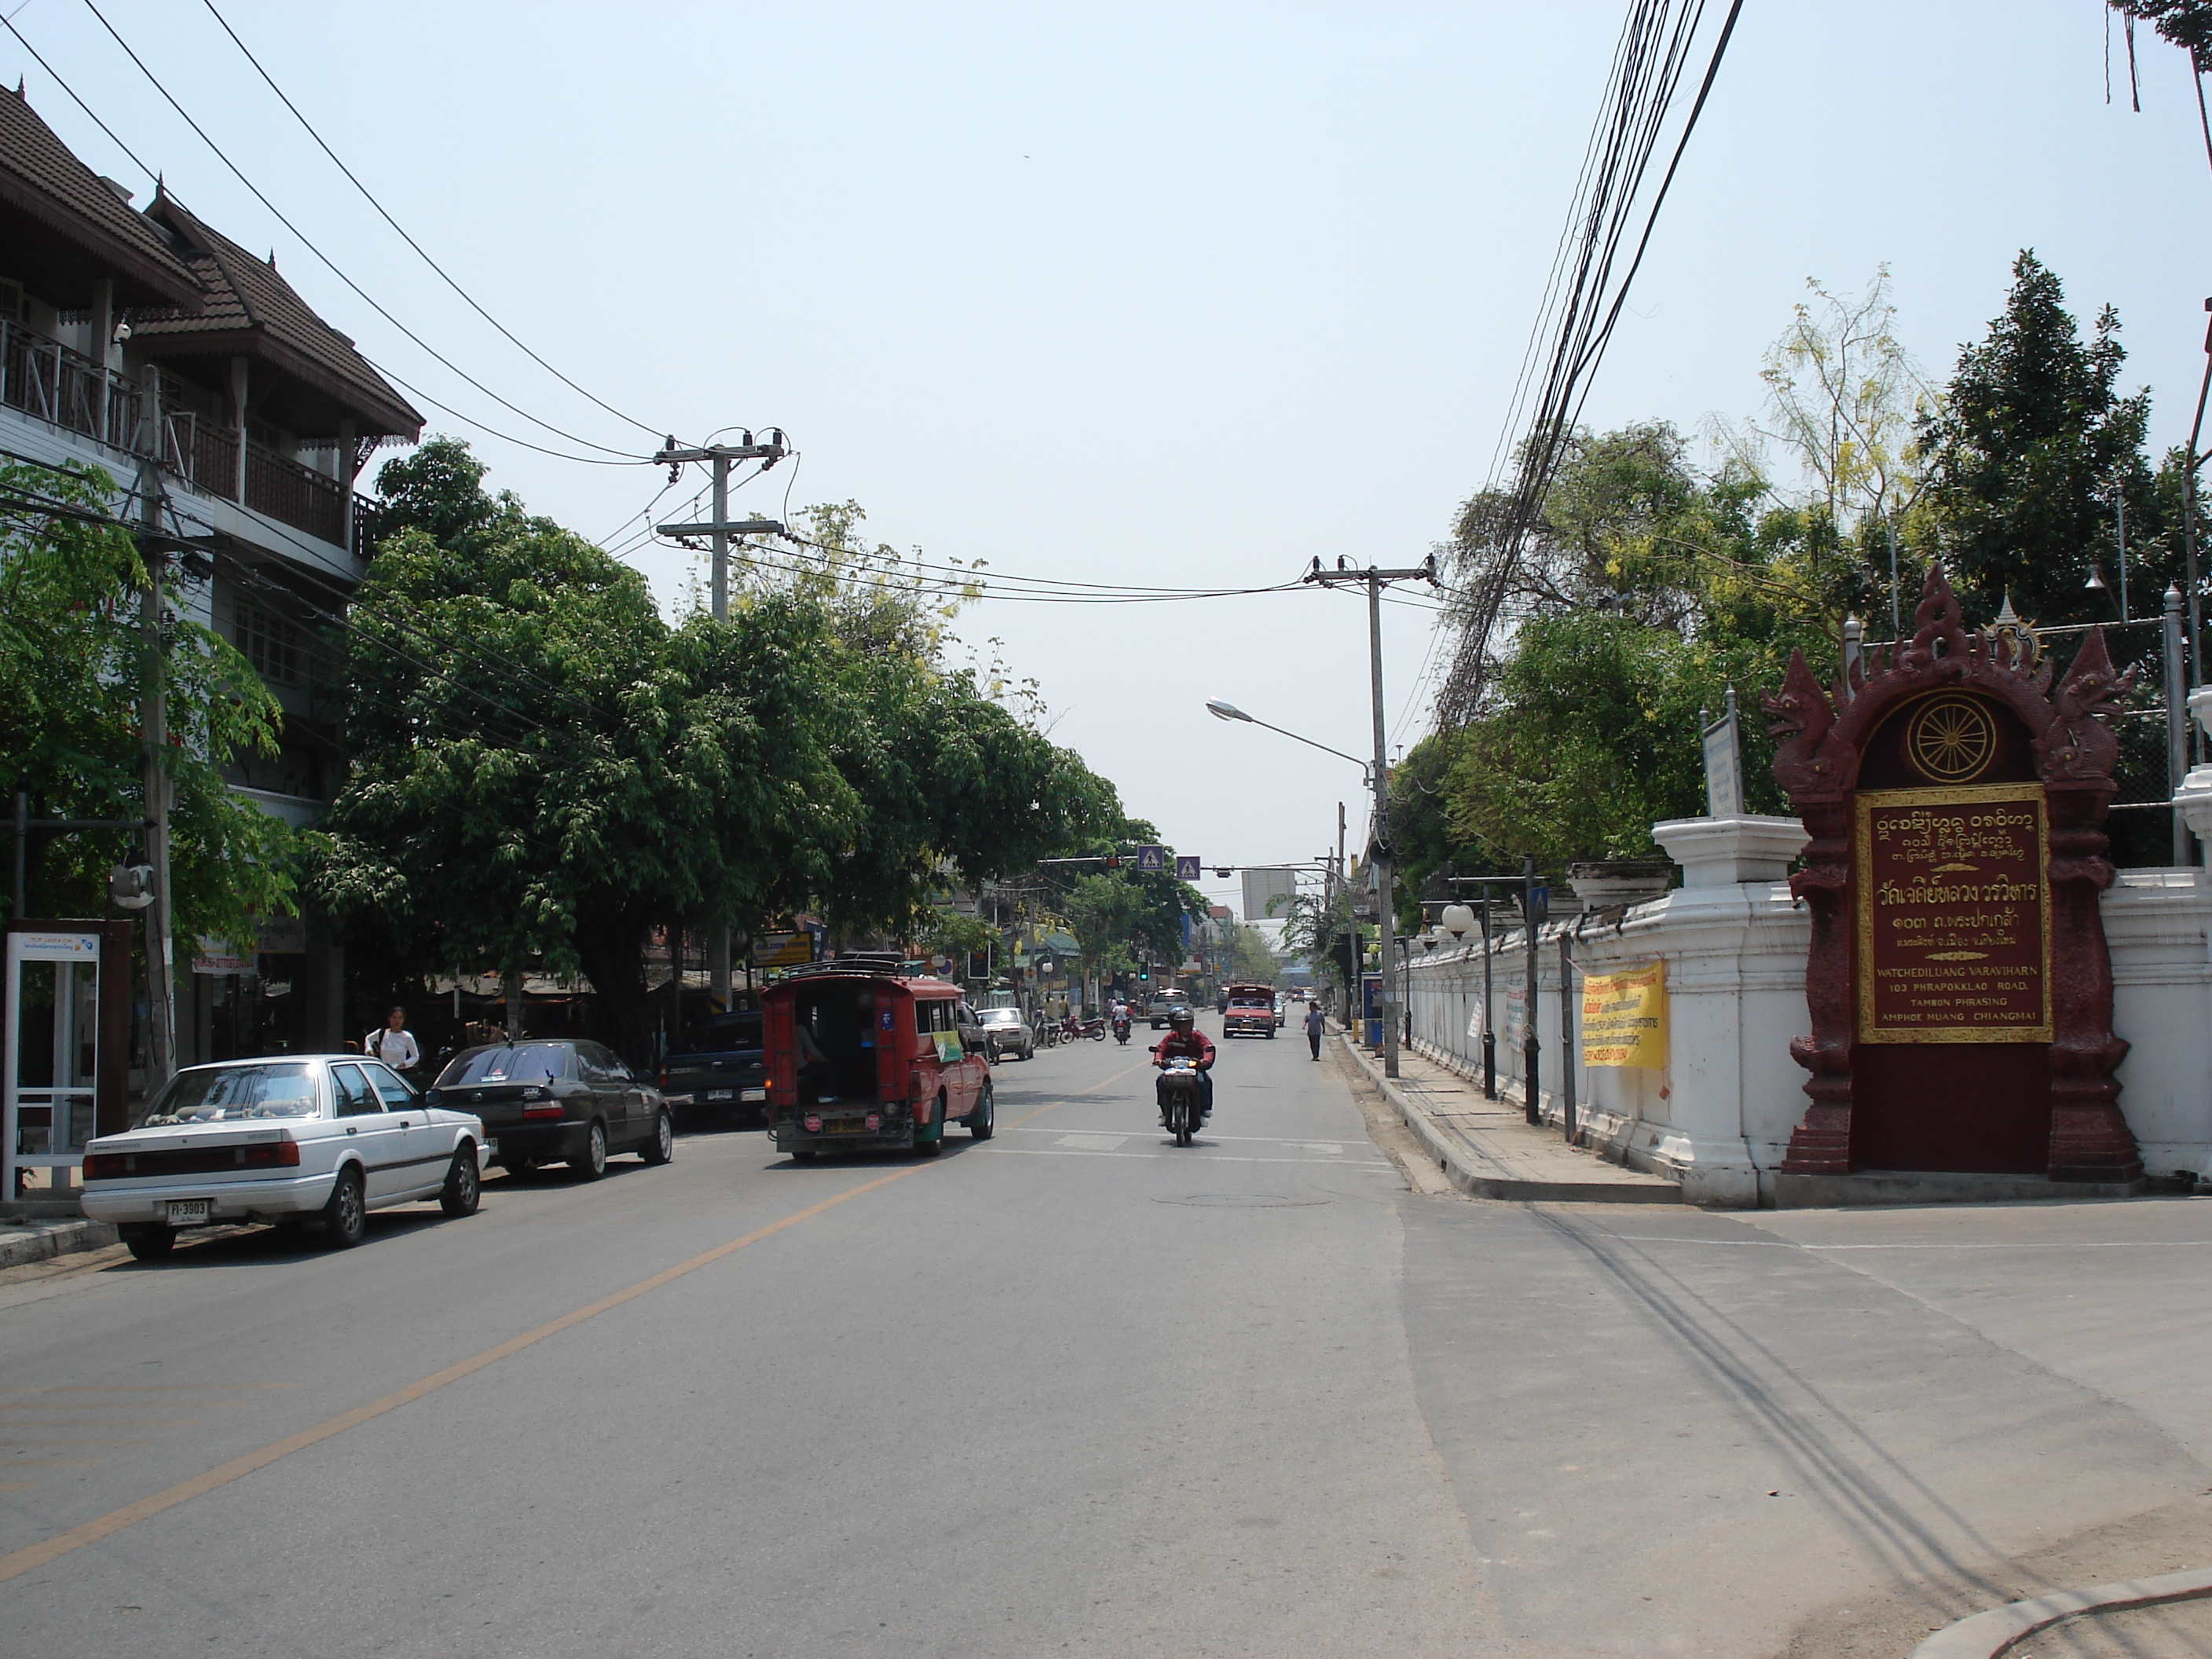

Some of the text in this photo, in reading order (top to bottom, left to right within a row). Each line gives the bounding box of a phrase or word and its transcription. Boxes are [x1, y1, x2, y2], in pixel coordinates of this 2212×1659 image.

[1981, 873, 2038, 903] วรวิหาร
[1892, 906, 2020, 929] ๑๐๓ ถ.พระปกเกล้า
[1877, 966, 2038, 977] WATCHEDILUANG VARAVIHARN
[1914, 983, 1987, 992] PHRAPOKKLAO
[1997, 982, 2028, 991] ROAD.
[1910, 998, 2008, 1007] TAMBON PHRASING
[1927, 1013, 1965, 1021] MUANG
[1973, 1012, 2036, 1021] CHIANGMAI
